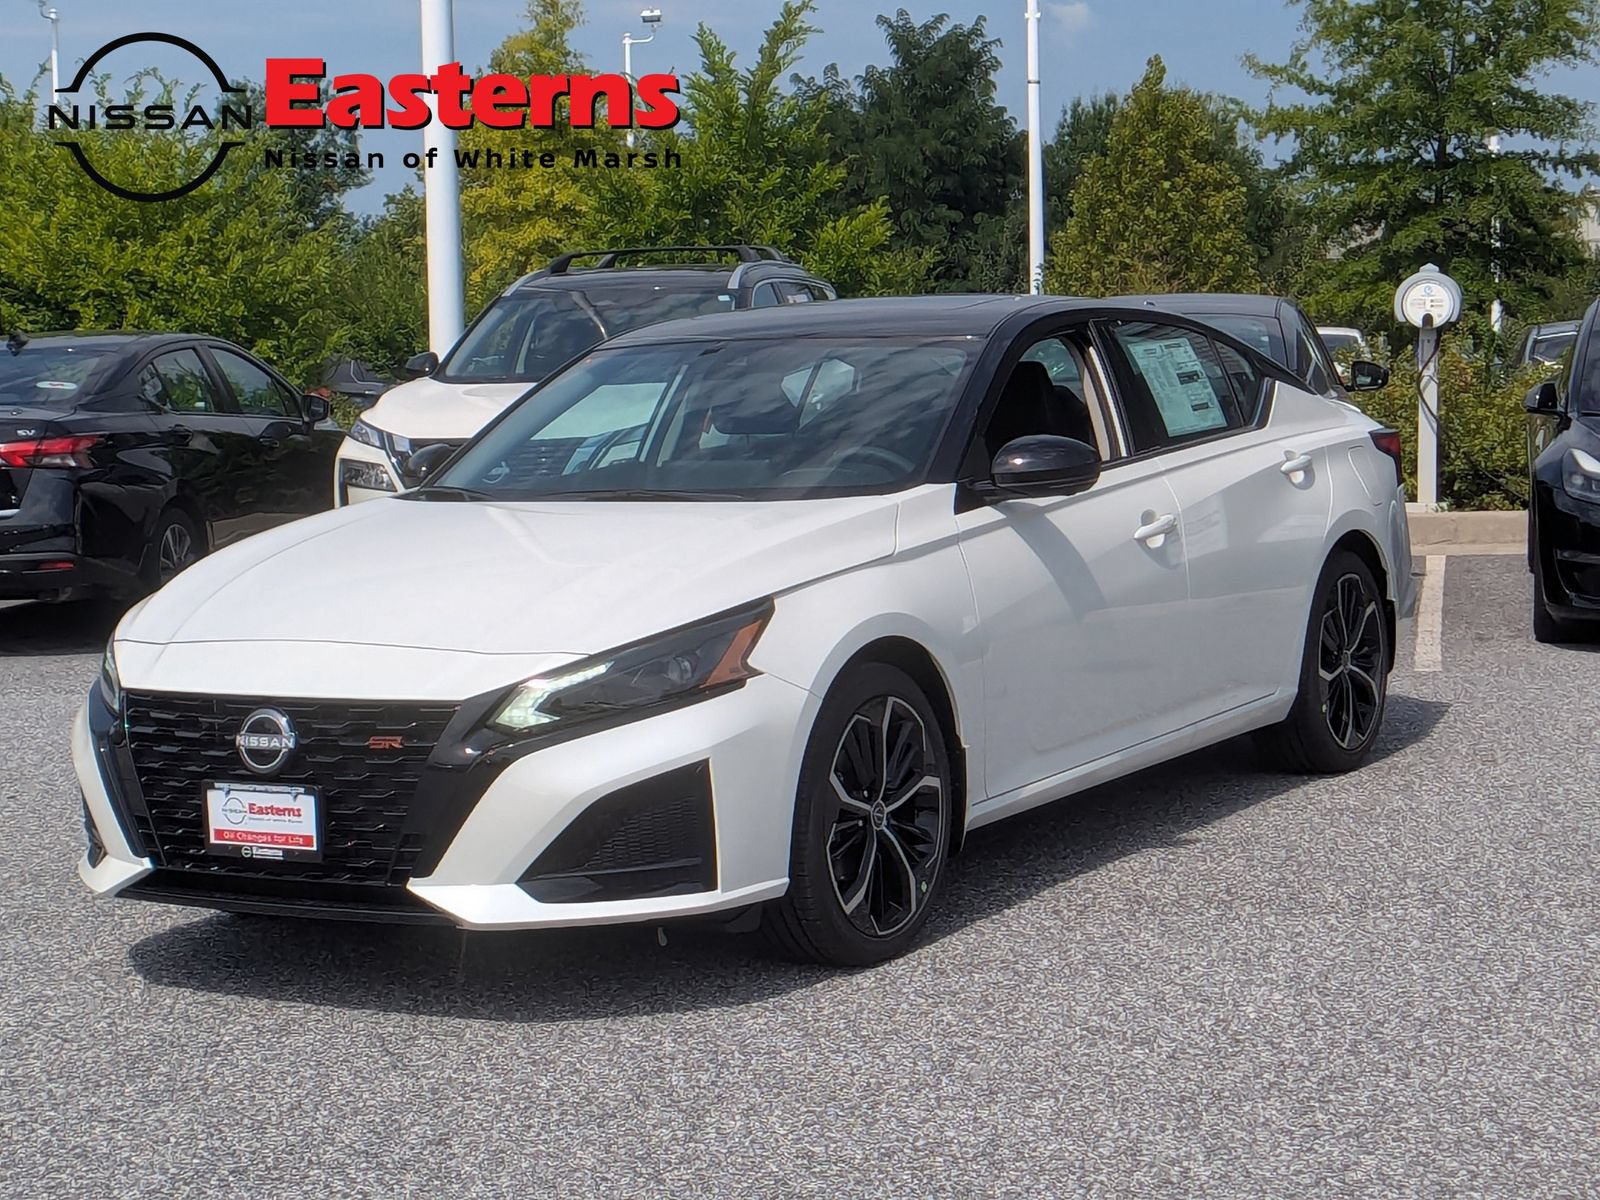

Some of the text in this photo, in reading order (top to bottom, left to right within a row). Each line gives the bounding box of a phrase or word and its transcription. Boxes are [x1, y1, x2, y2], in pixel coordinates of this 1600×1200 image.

[236, 735, 295, 748] NISSAN
[369, 735, 404, 748] SR
[248, 803, 302, 817] Easterns
